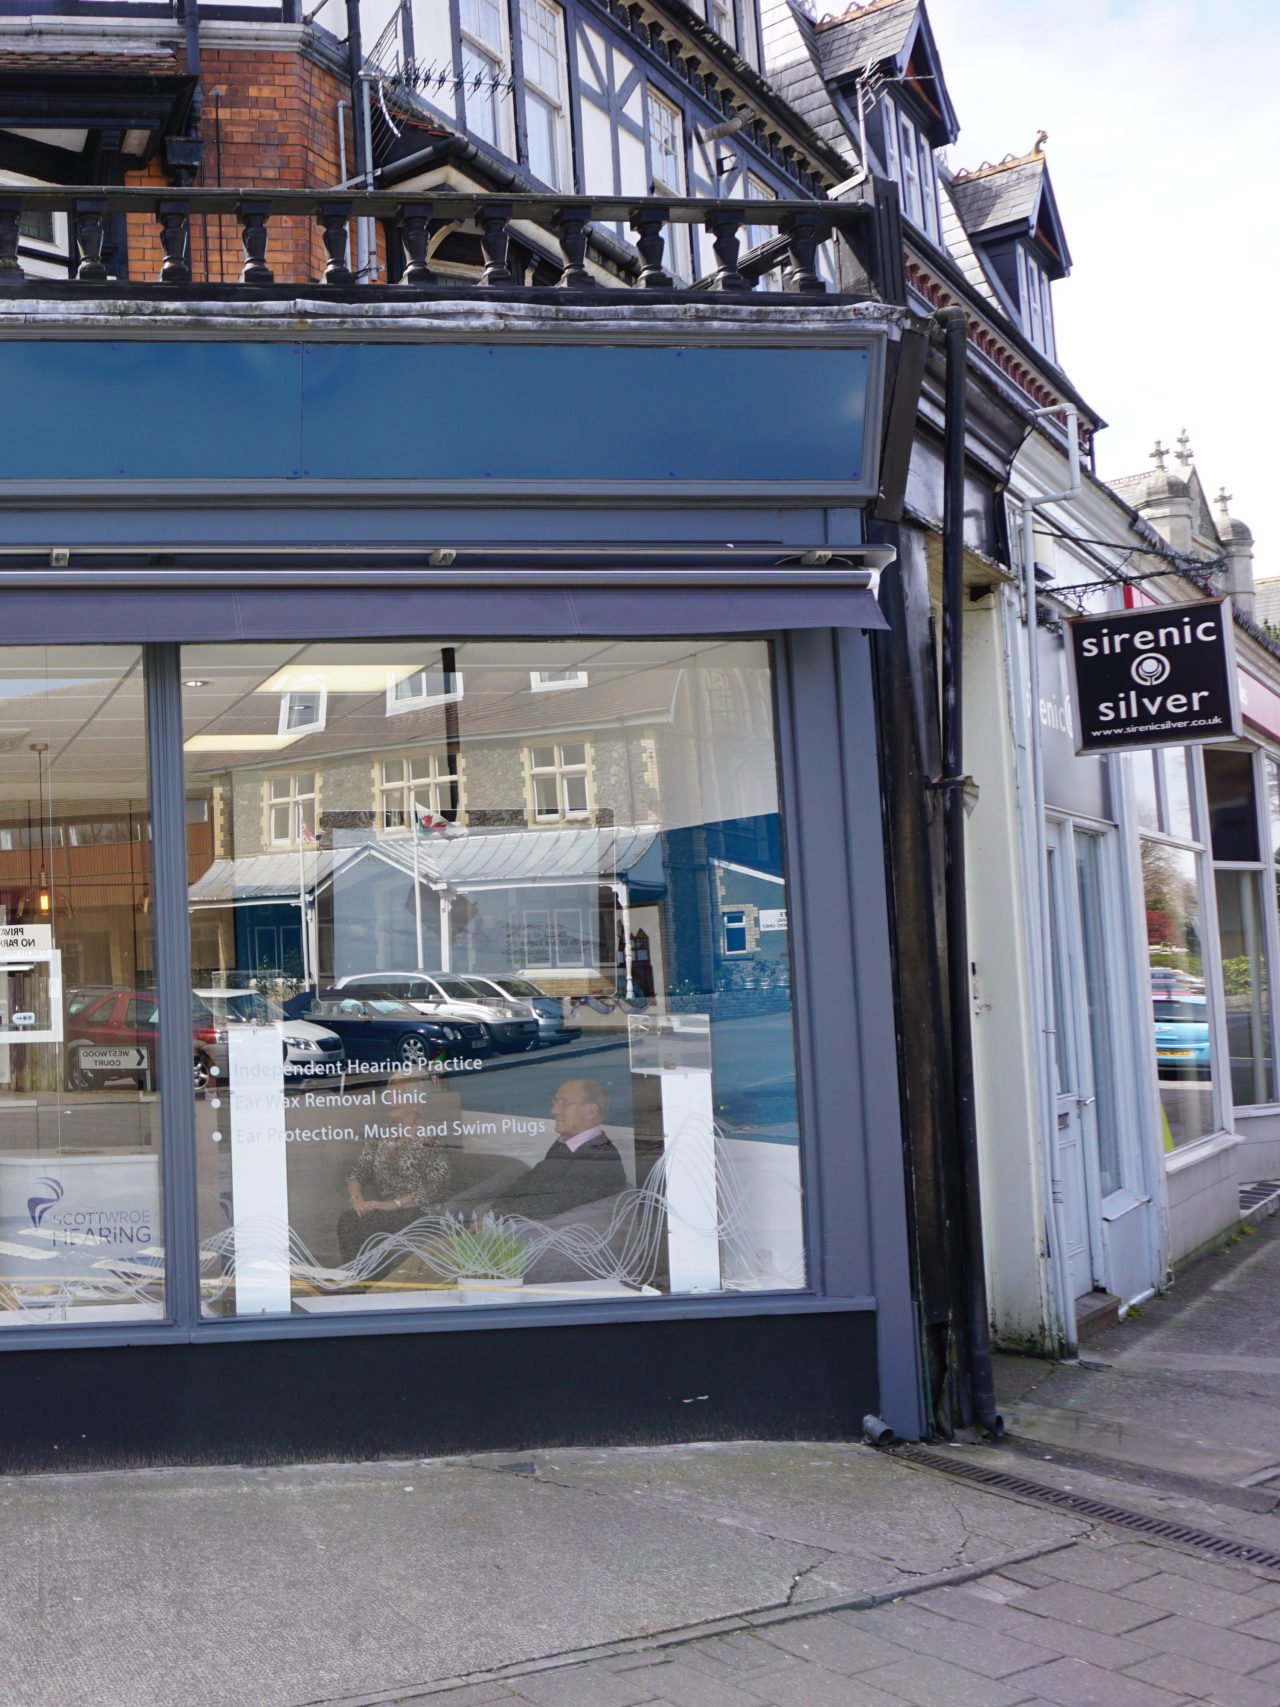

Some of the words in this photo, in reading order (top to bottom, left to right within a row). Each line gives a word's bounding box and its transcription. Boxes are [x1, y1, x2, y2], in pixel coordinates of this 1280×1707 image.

[1082, 617, 1217, 657] sirenic
[1098, 689, 1209, 722] silver
[1091, 715, 1222, 737] www.sirenicsilver.co.uk
[233, 1060, 343, 1078] Independent
[347, 1057, 412, 1076] Hearing
[418, 1056, 483, 1071] Practice
[265, 1094, 300, 1109] Wax
[305, 1090, 376, 1107] Removal
[381, 1089, 427, 1105] Clinic
[267, 1125, 359, 1142] Protection,
[364, 1122, 412, 1139] Music
[416, 1120, 447, 1136] and
[452, 1118, 496, 1135] Swim
[502, 1117, 546, 1135] Plugs
[53, 1210, 151, 1226] SCOTTWROE
